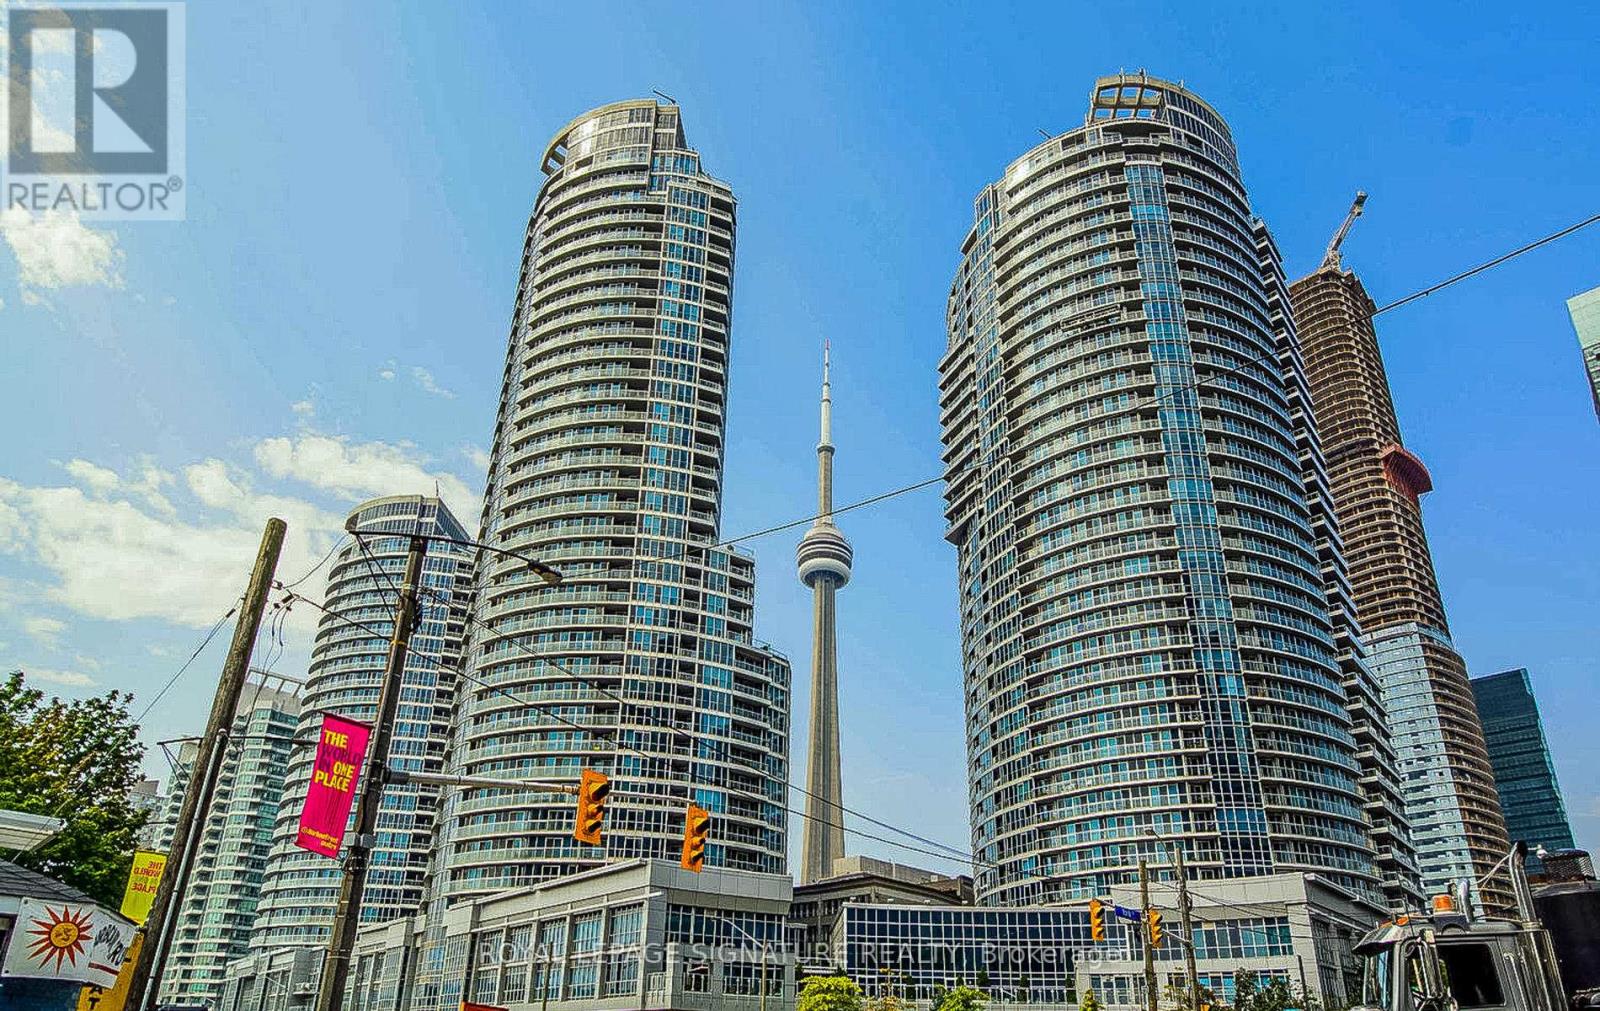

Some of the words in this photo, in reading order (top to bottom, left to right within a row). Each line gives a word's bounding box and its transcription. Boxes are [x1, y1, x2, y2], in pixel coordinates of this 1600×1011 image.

[324, 729, 349, 749] THE
[322, 746, 361, 764] WORLD
[333, 761, 355, 779] ONE
[314, 770, 350, 792] PLACE
